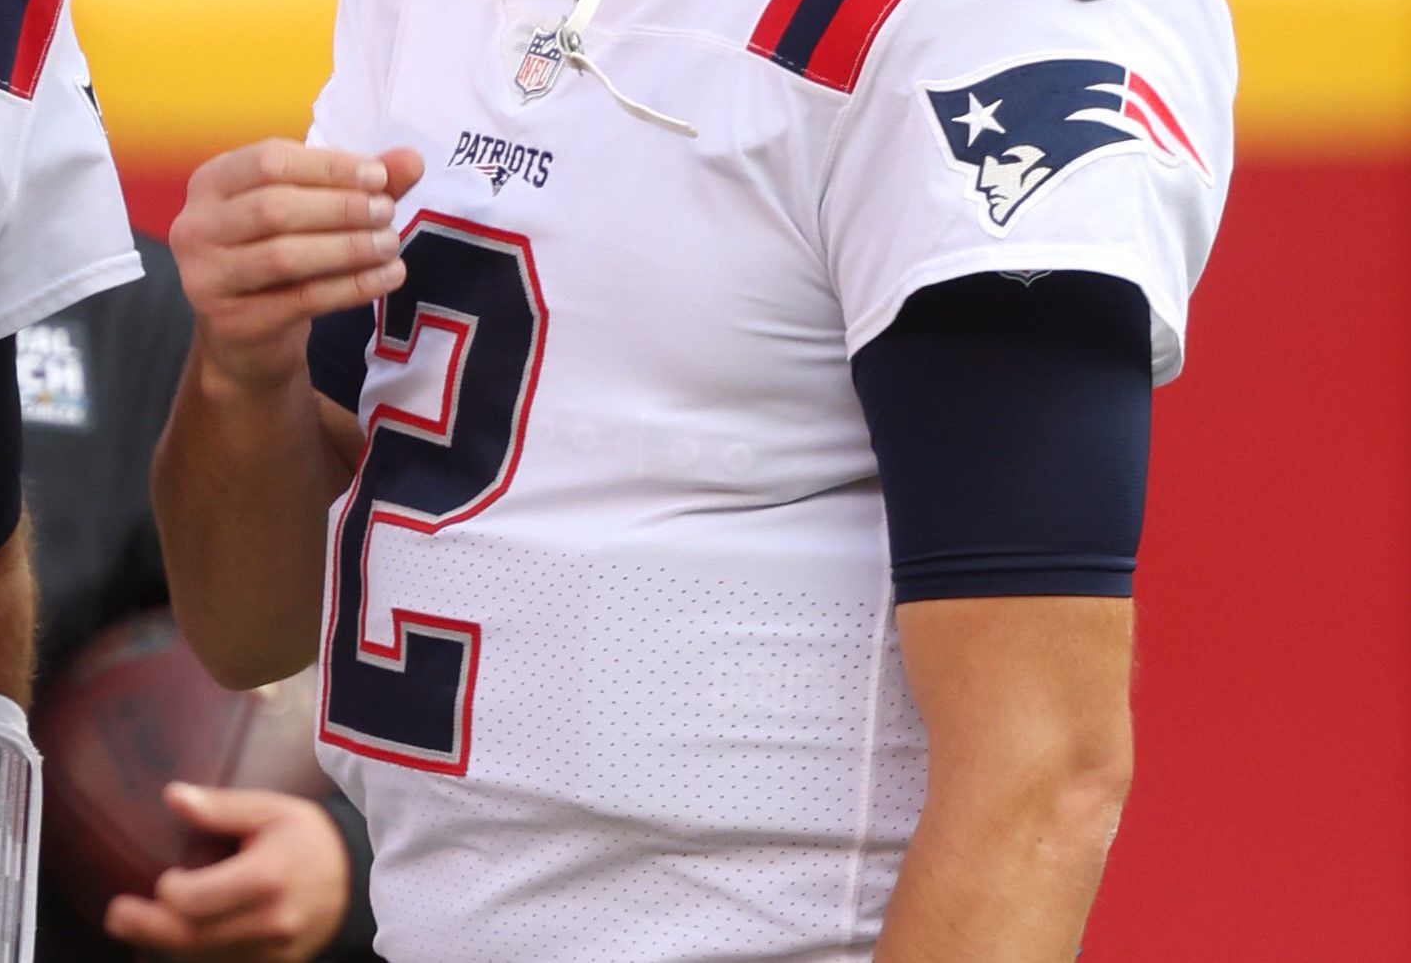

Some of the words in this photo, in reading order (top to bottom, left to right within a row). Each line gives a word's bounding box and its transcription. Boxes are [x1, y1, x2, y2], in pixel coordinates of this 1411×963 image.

[518, 55, 553, 88] NFL
[447, 130, 554, 189] PATRIOTS
[319, 209, 549, 777] 2
